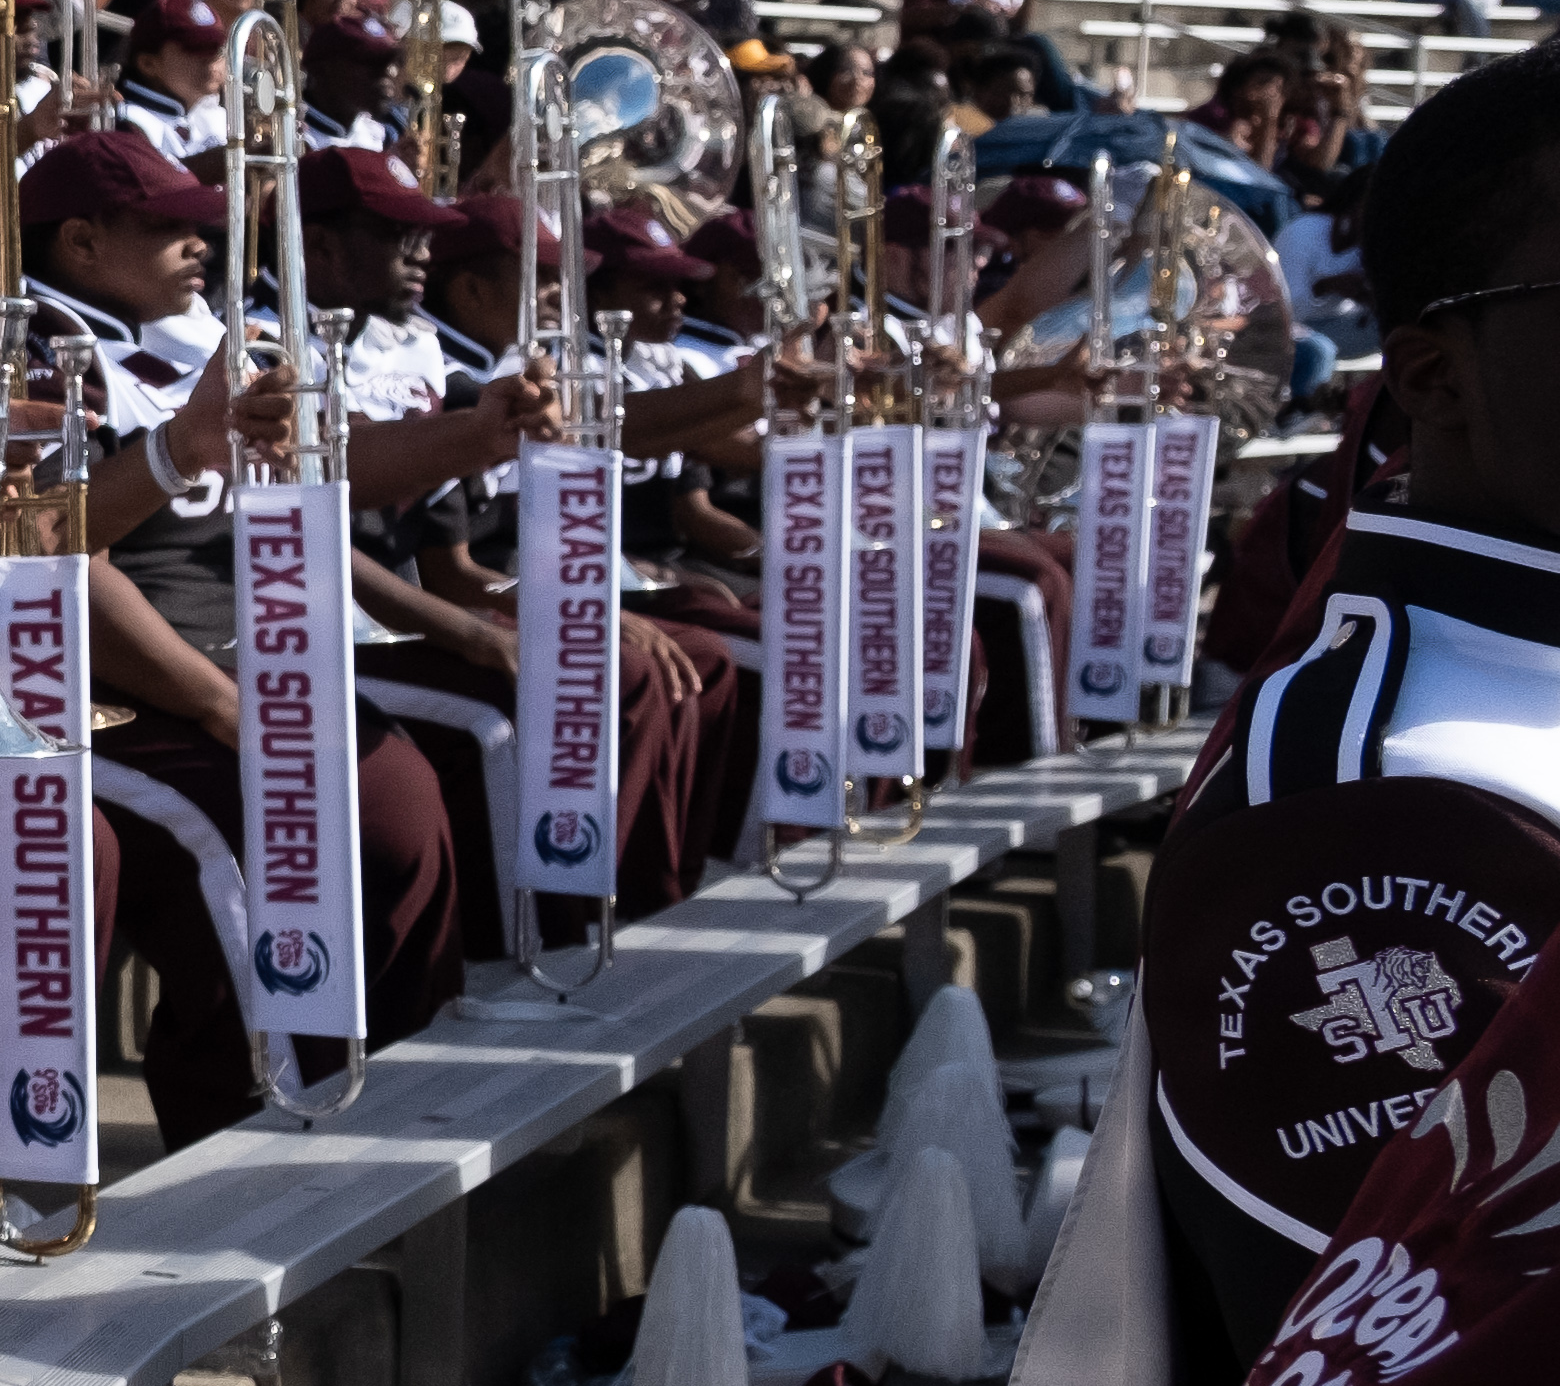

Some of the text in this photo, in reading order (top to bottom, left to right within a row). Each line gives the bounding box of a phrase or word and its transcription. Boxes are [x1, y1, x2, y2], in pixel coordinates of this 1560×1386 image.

[559, 465, 607, 586] TEXAS
[783, 450, 825, 555] TEXAS
[855, 446, 896, 539] TEXAS
[1089, 439, 1135, 648] TEXAS SOUTHERN
[1150, 432, 1199, 622] TEXAS SOUTHERN
[248, 507, 309, 656] TEXAS
[782, 564, 825, 732] SOUTHERN
[857, 549, 899, 696] SOUTHERN
[923, 540, 959, 674] SOUTHERN
[549, 597, 606, 791] SOUTHERN
[8, 589, 74, 1039] TEXA SOUTHERN
[256, 670, 320, 905] SOUTHERN
[1219, 920, 1287, 1070] TEXAS
